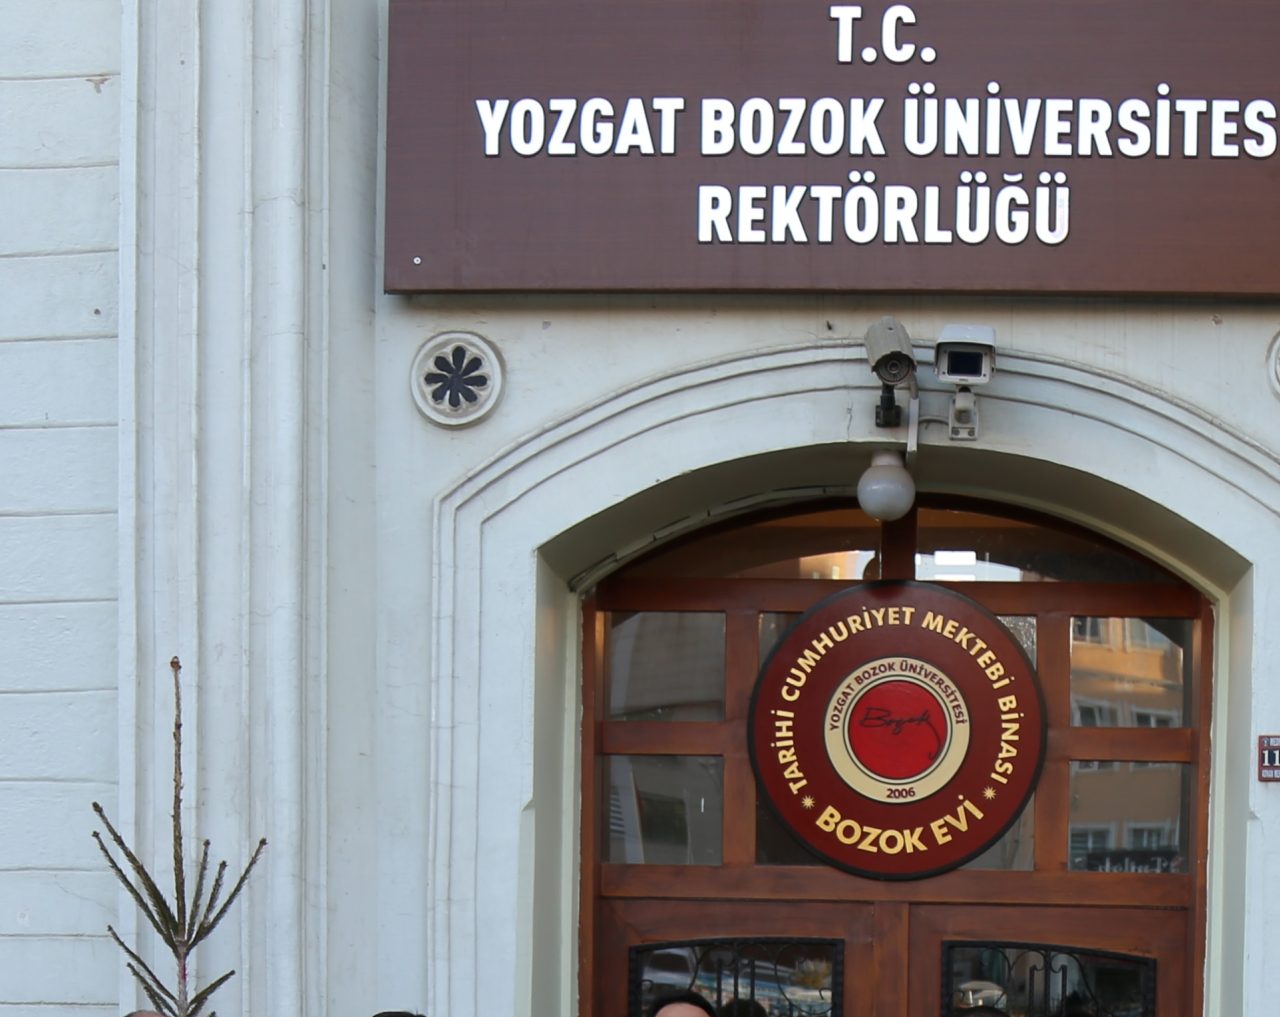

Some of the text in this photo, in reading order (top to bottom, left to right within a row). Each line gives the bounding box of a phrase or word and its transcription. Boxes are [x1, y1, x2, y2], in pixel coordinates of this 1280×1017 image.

[829, 4, 937, 64] T.C.
[475, 97, 685, 156] YOZGAT
[701, 97, 887, 156] BOZOK
[697, 170, 1071, 245] REKTÖRLÜĞÜ
[770, 605, 1025, 795] TARİHİ CUMHURİYET MEKTEBİ BİNASI
[829, 659, 968, 731] YOZGAT BOZOK ÜNİVERSİTESİ
[886, 787, 916, 799] 2006
[815, 794, 985, 855] BOZOK EVİ
